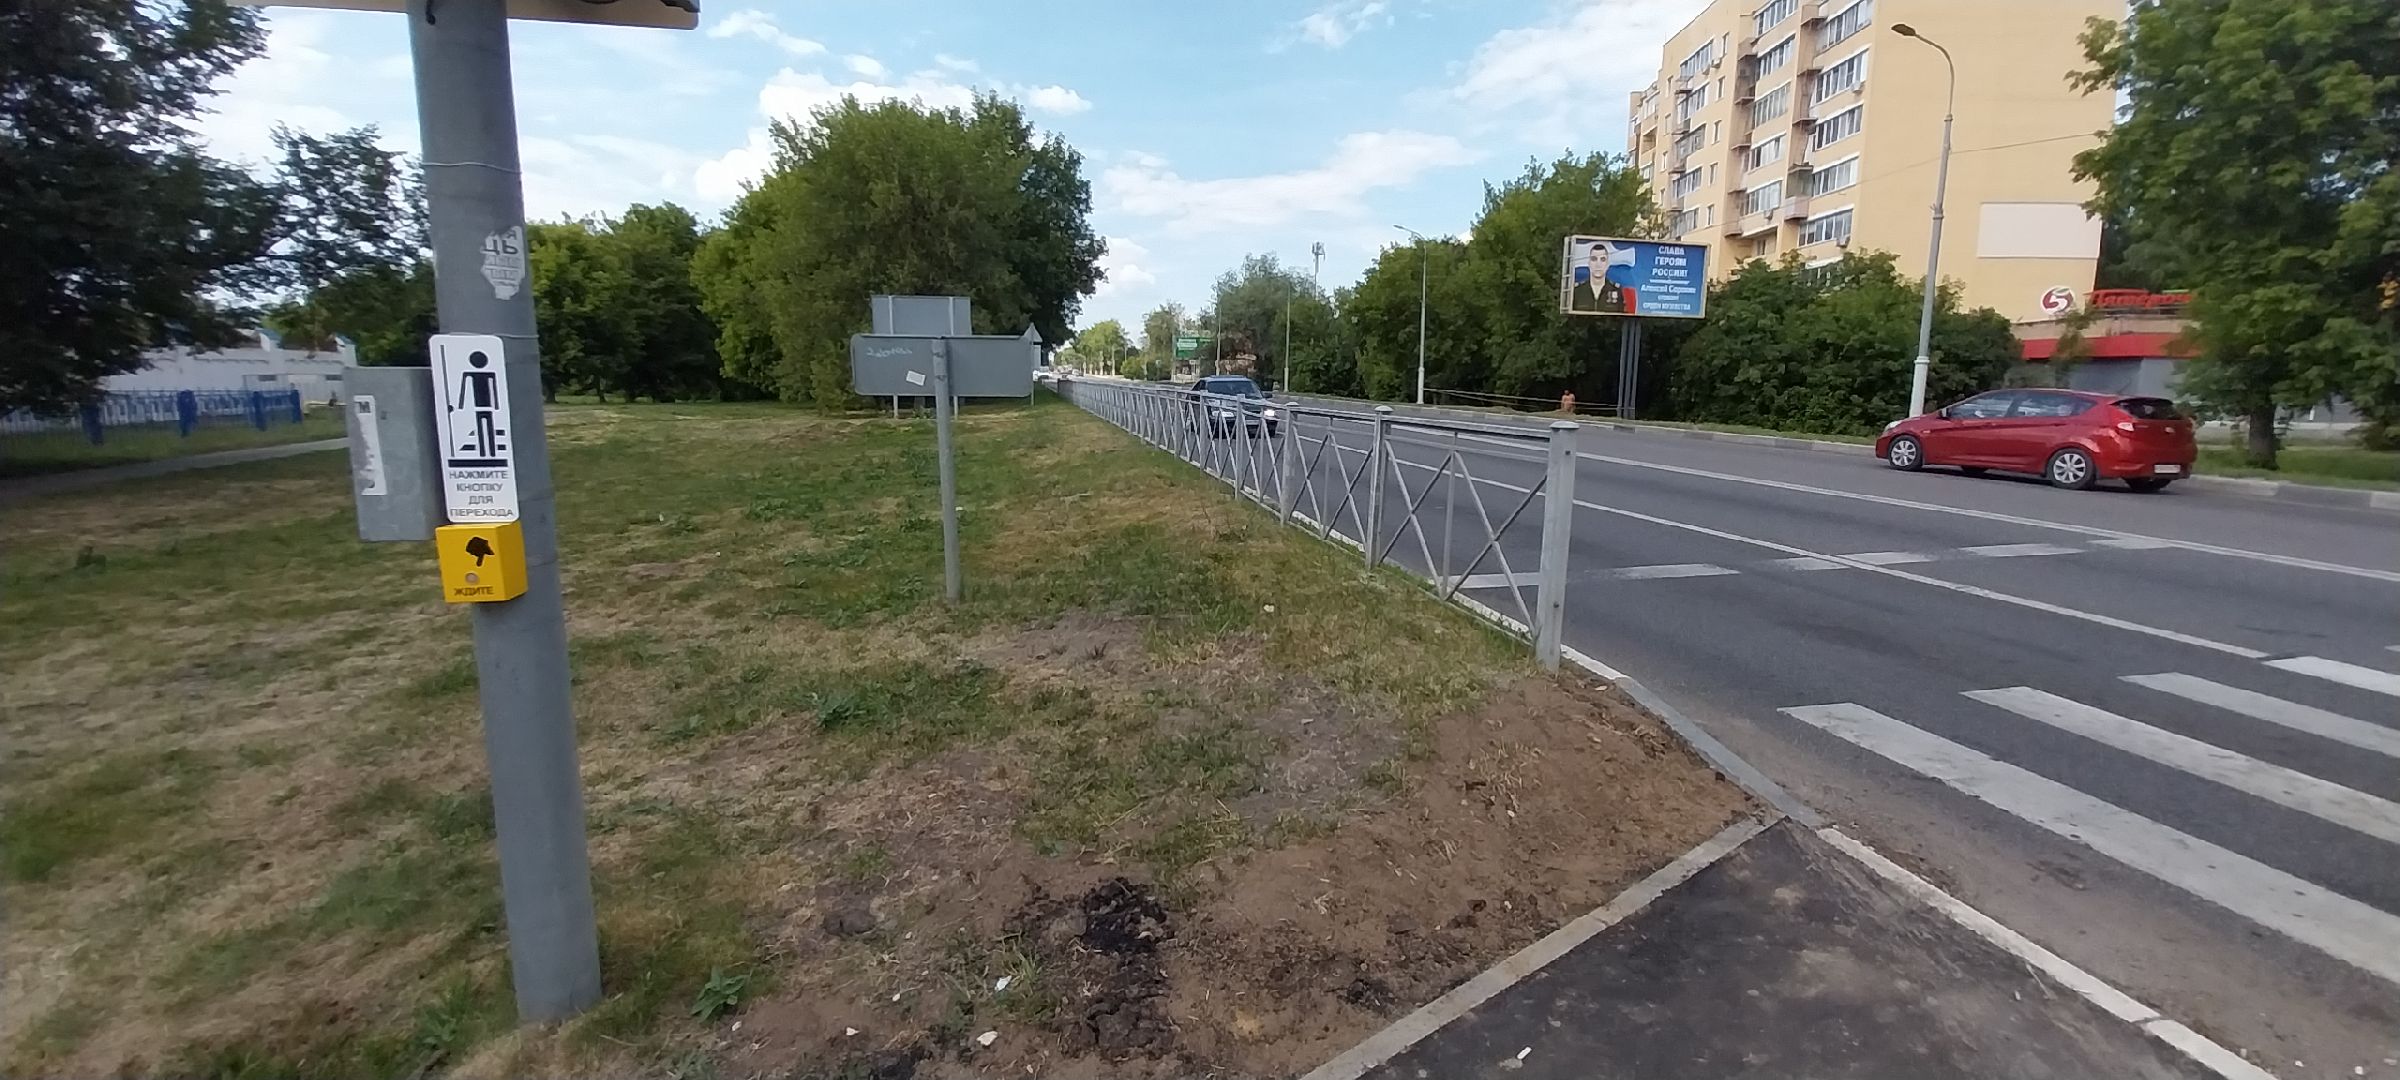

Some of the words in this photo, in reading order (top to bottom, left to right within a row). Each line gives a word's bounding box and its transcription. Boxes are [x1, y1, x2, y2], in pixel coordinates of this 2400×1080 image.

[1659, 246, 1685, 255] СЛАВА
[1655, 257, 1686, 266] ГЕРОЯМ
[449, 470, 508, 479] НАЖМИТЕ
[456, 483, 504, 492] КНОПКУ
[468, 495, 494, 505] ДЛЯ
[450, 508, 514, 517] ПЕРЕХОДА
[454, 586, 494, 596] ЖДИТЕ
